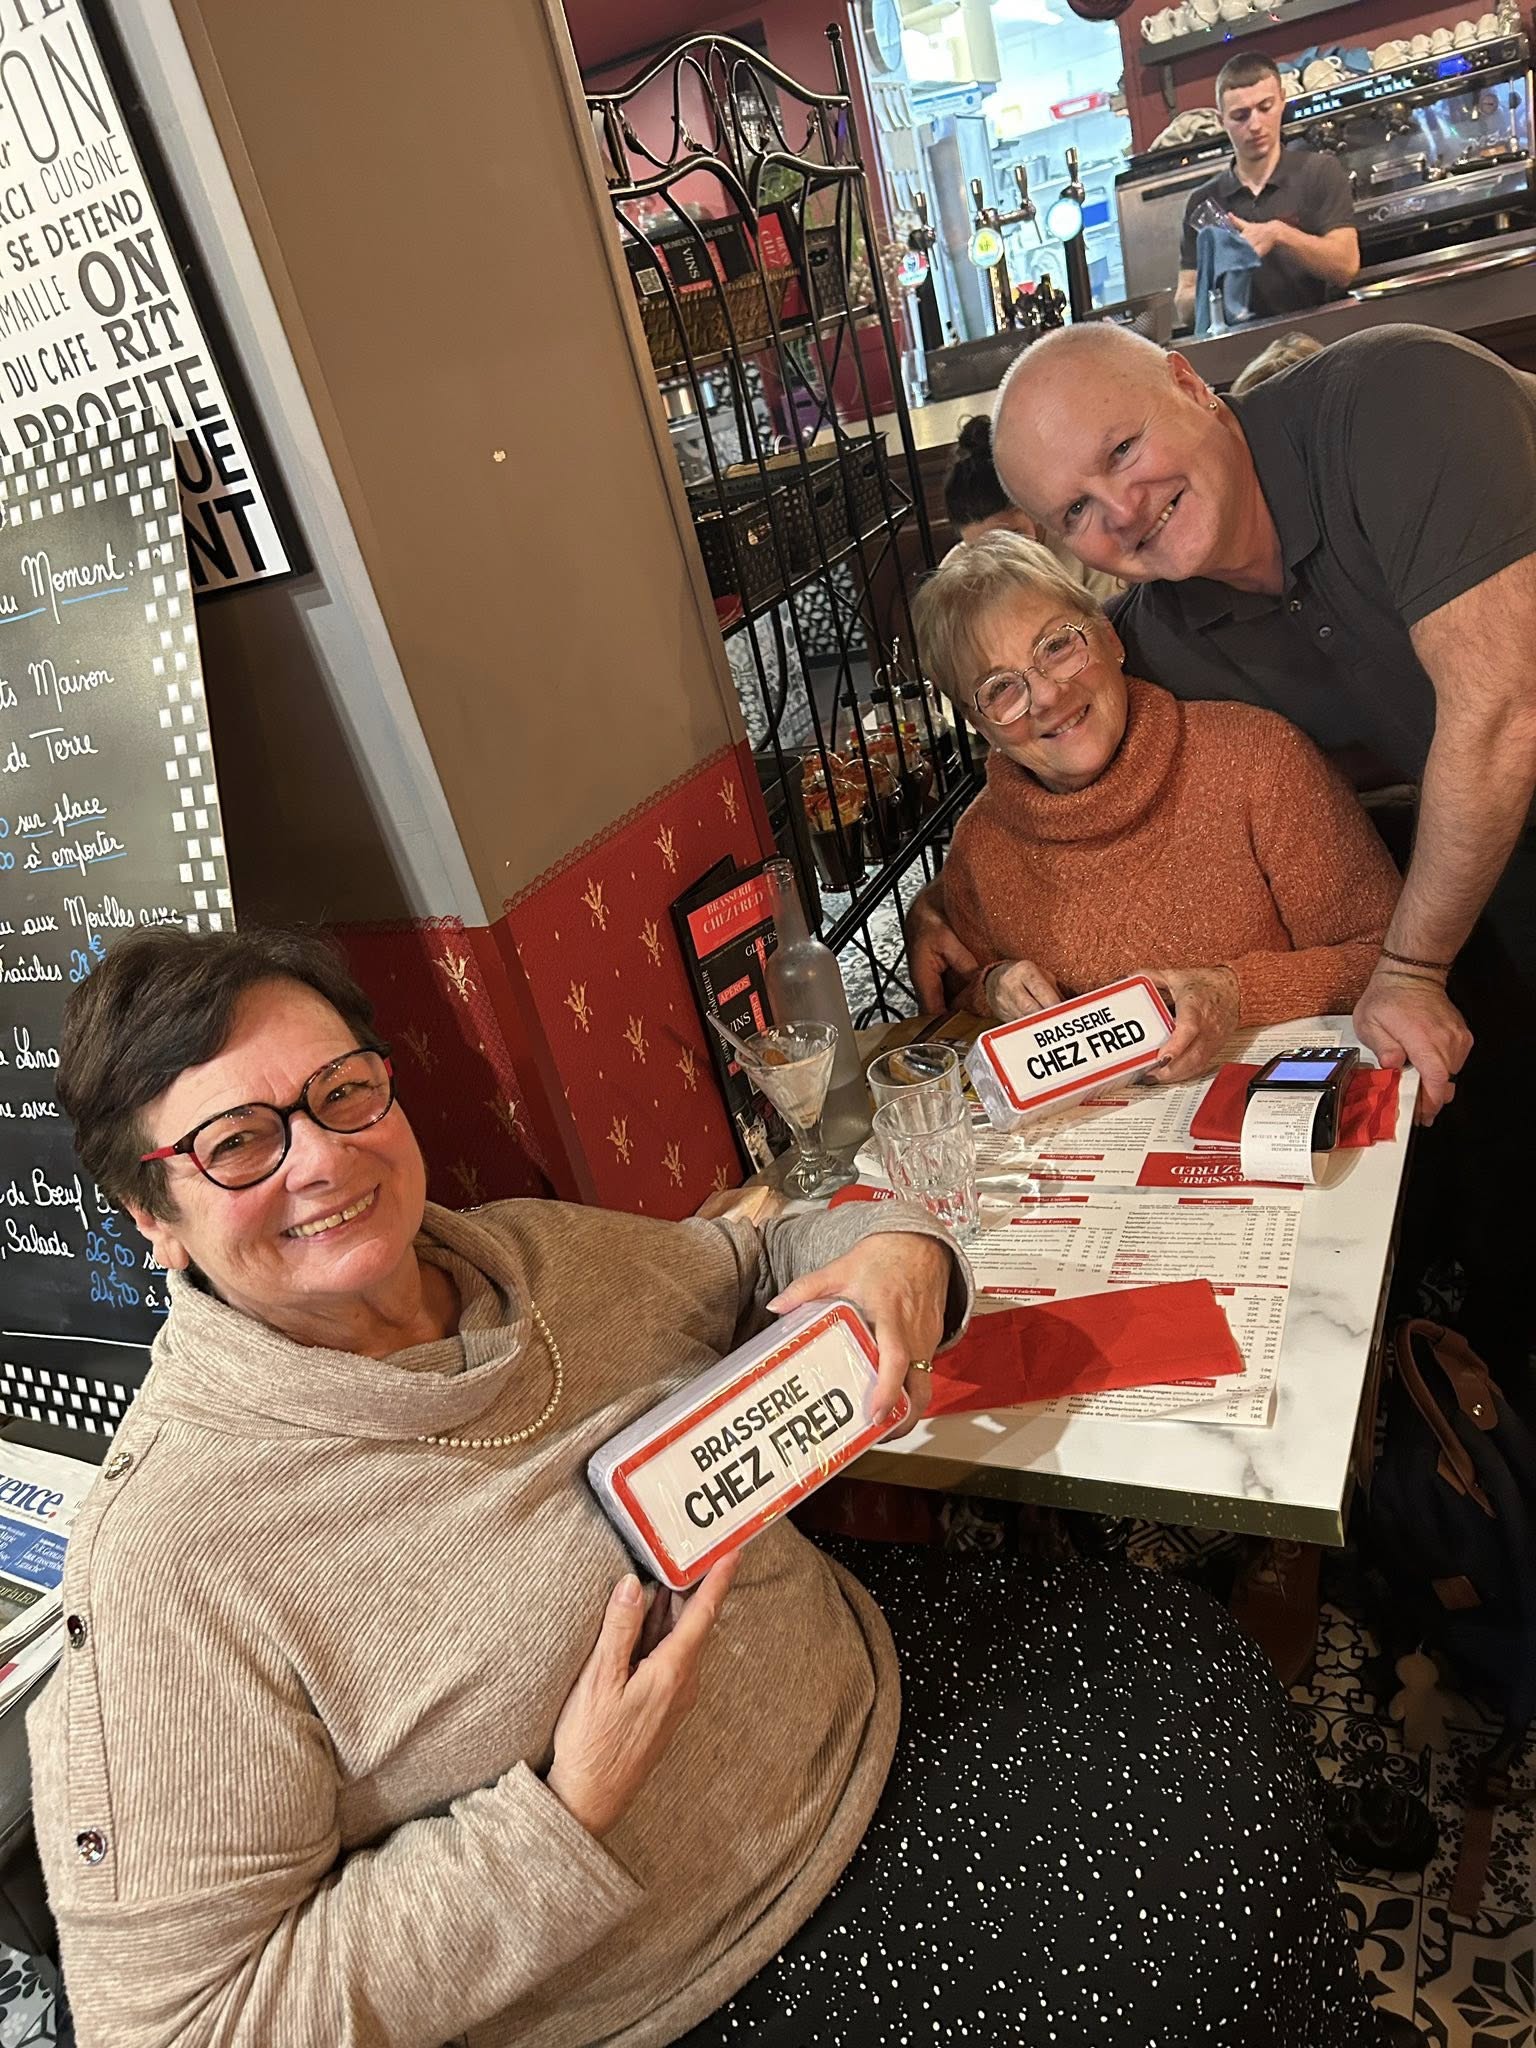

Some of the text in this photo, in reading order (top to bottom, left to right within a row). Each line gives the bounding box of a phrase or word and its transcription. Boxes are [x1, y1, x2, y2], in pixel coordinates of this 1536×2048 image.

[40, 134, 129, 205] CUISINE
[6, 189, 143, 271] SE DETEND
[0, 228, 171, 342] MAILLE ON
[682, 247, 700, 279] VINS
[2, 298, 184, 398] DU CAFE RIT
[28, 659, 114, 712] Maison
[3, 727, 99, 773] de Terre
[15, 812, 46, 835] sur
[52, 793, 107, 837] place
[23, 843, 42, 870] à
[52, 830, 124, 876] emporter
[21, 915, 59, 936] aux
[1027, 1019, 1146, 1080] CHEZ FRED
[1034, 1007, 1115, 1048] BRASSERIE
[20, 1100, 60, 1120] avec
[5, 1218, 75, 1258] Salade
[690, 1374, 809, 1472] BRASSERIE
[684, 1387, 854, 1529] CHEZ FRED
